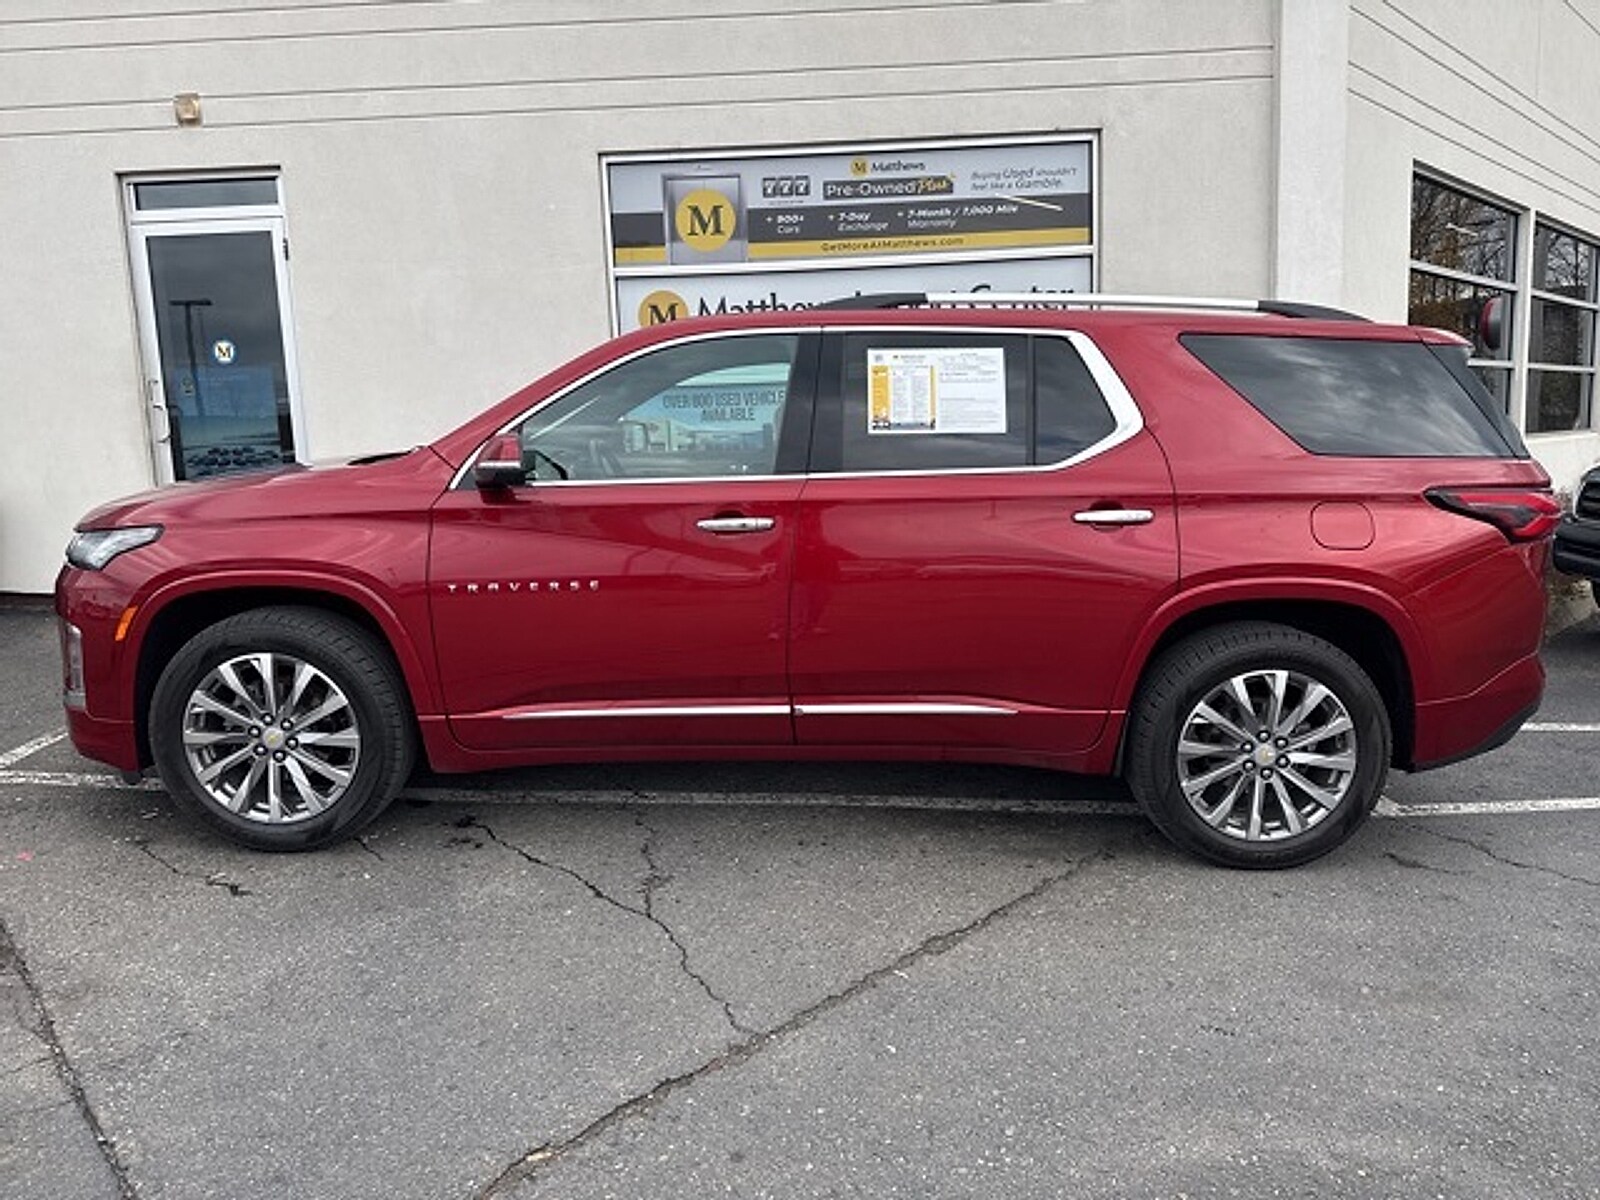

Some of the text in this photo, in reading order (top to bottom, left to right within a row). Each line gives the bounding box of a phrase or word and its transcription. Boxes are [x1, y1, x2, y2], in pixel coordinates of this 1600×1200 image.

[871, 161, 926, 172] Matthews
[827, 179, 916, 196] Pre-Owned
[687, 205, 725, 236] M
[838, 221, 889, 232] Exchange
[648, 303, 679, 326] M
[217, 345, 231, 358] M
[447, 579, 600, 593] TRAVERSE
